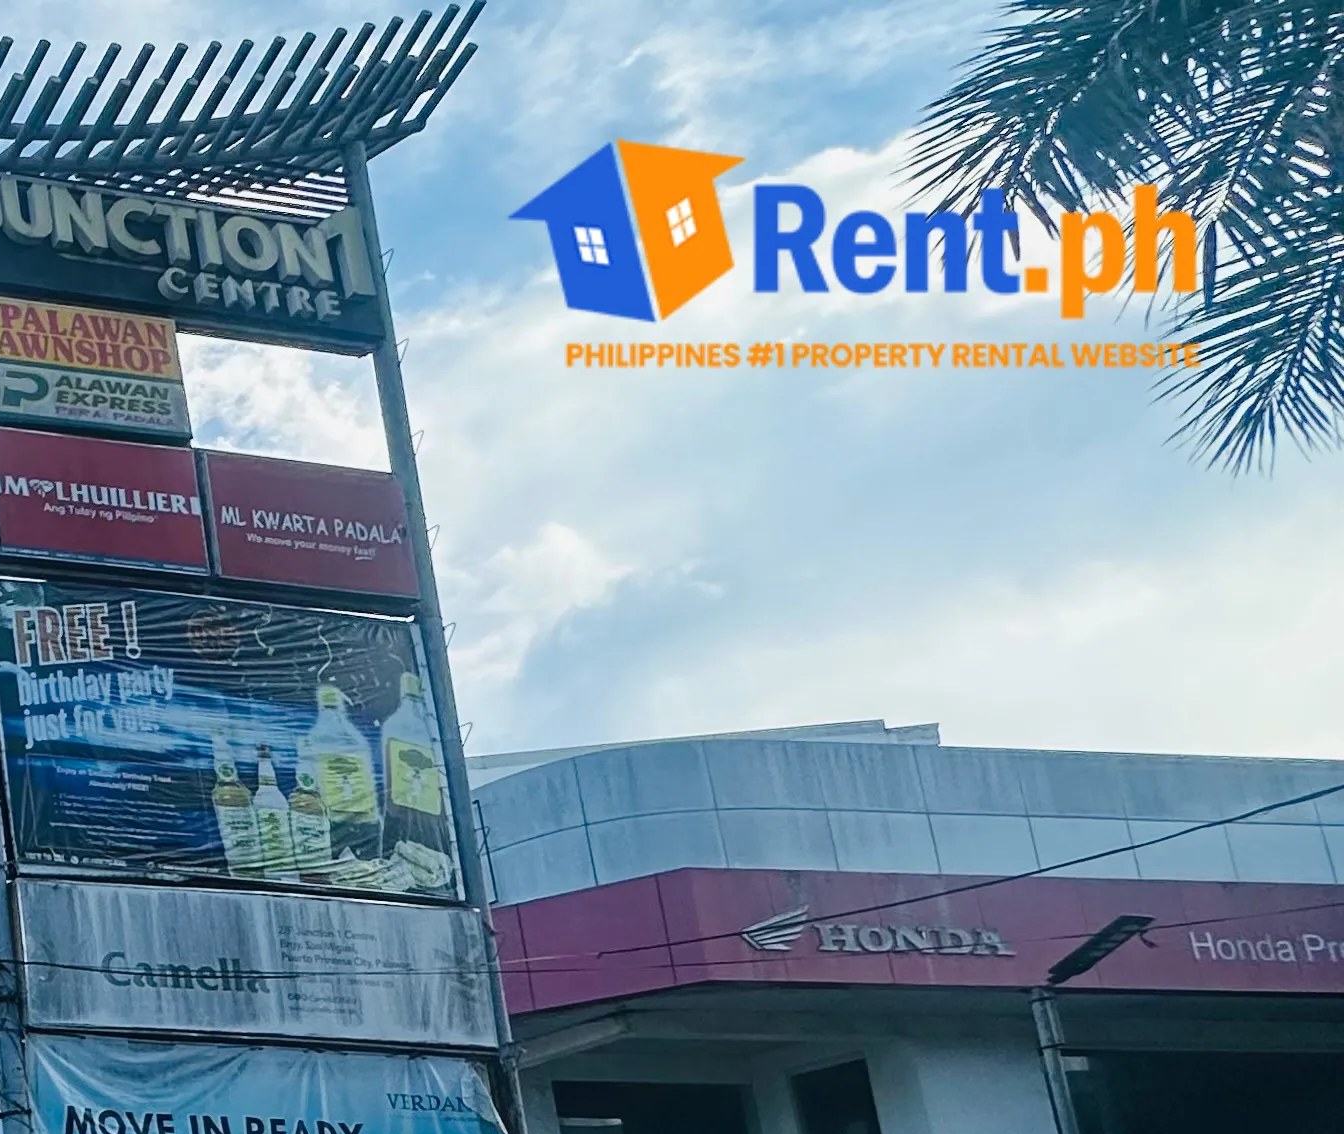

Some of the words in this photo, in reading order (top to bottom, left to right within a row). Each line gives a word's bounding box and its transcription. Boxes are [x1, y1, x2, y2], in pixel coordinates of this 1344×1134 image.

[318, 204, 378, 300] 1
[158, 266, 343, 323] CENTRE
[0, 303, 169, 350] PALAWAN
[55, 390, 172, 415] EXPRESS
[55, 406, 104, 419] PERA
[113, 412, 175, 427] PADALA
[44, 502, 66, 516] Ang
[69, 505, 96, 519] Tulay
[100, 509, 113, 521] ng
[116, 509, 155, 524] Pilipino
[221, 505, 247, 527] ML
[252, 509, 329, 536] KWARTA
[334, 518, 402, 545] PADALA
[246, 532, 263, 544] We
[264, 536, 293, 547] move
[294, 540, 317, 550] your
[319, 542, 352, 556] money
[13, 601, 113, 667] FREE
[17, 667, 112, 706] birthday
[117, 665, 174, 704] party
[24, 708, 70, 750] just
[73, 704, 105, 738] for
[812, 923, 1017, 958] HONDA
[1189, 931, 1297, 962] Honda
[1301, 933, 1344, 962] Pr
[101, 951, 270, 995] Camella
